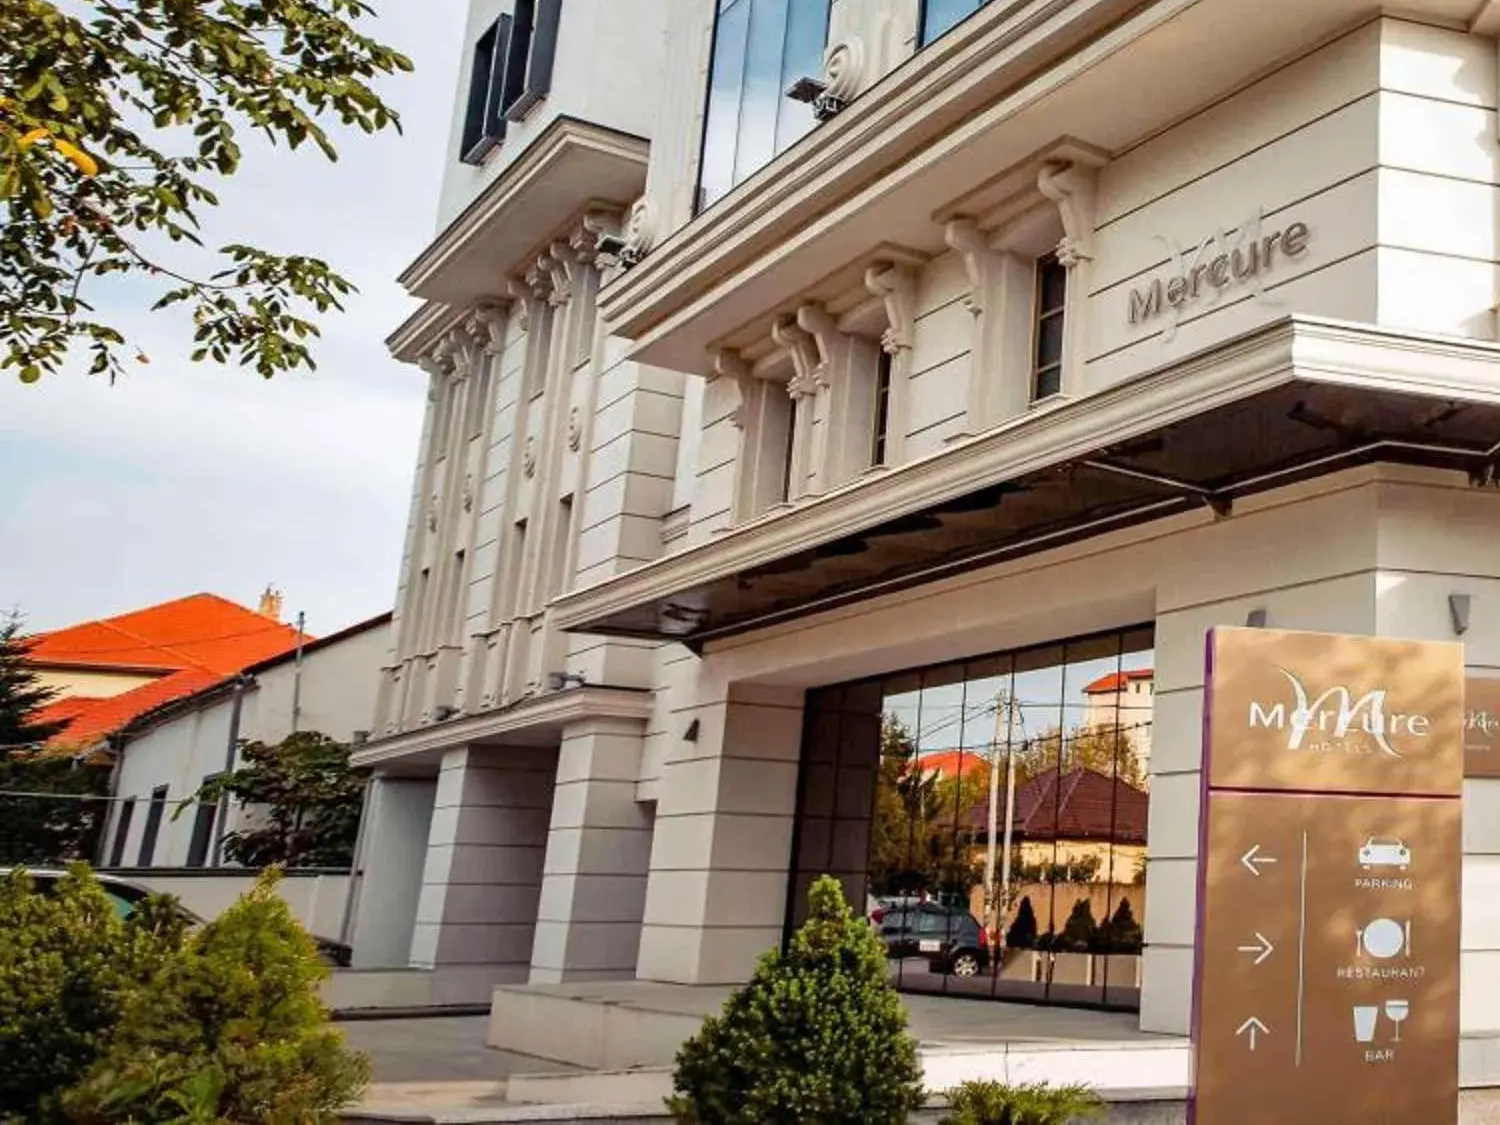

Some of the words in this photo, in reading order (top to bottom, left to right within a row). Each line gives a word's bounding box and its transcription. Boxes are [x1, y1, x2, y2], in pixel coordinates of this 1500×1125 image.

[1126, 221, 1309, 324] Mercure
[1354, 878, 1413, 890] PARKING
[1337, 966, 1425, 979] RESTAURANT
[1364, 1049, 1395, 1063] BAR
